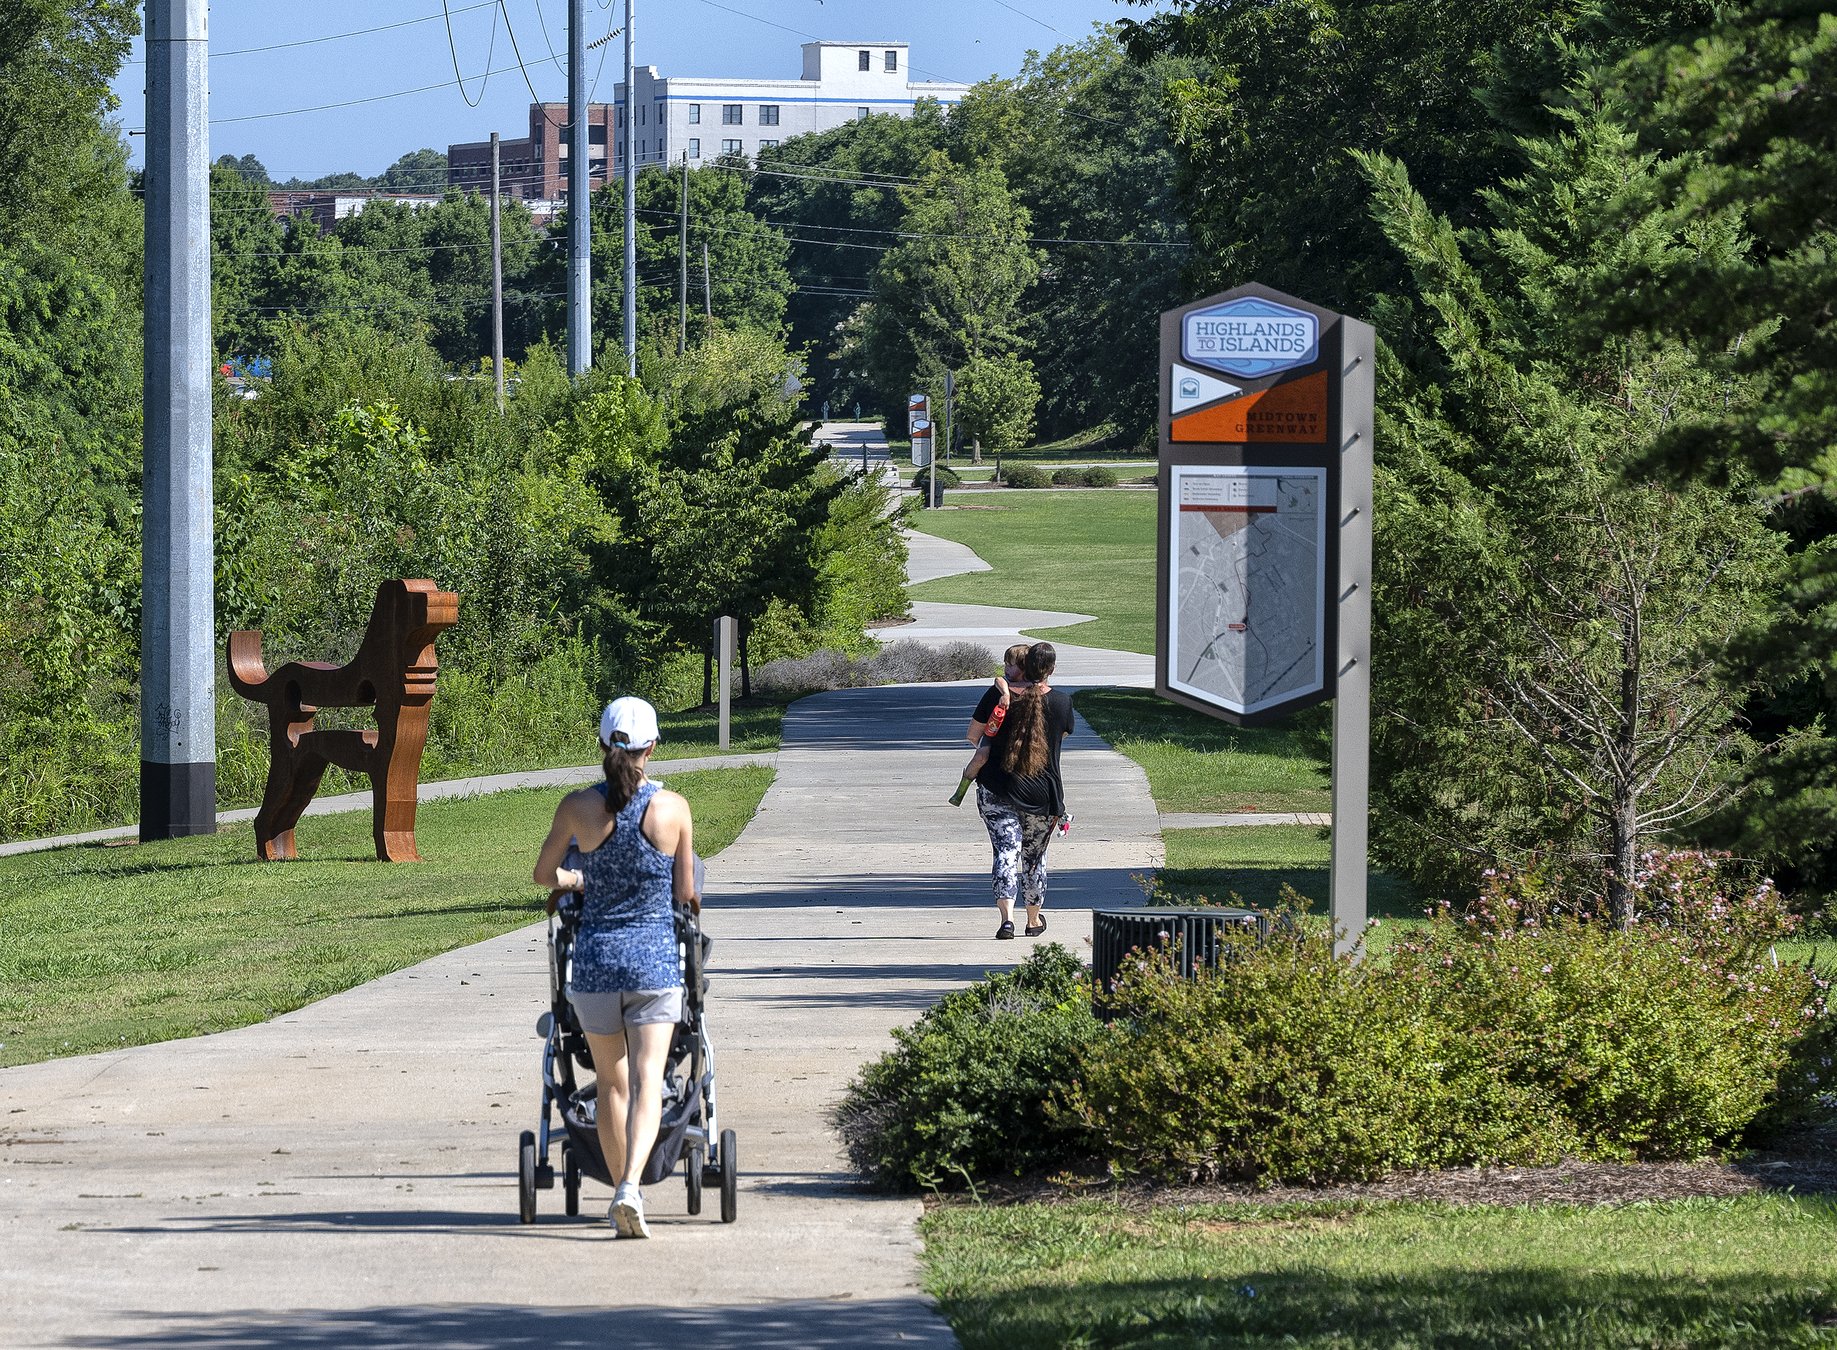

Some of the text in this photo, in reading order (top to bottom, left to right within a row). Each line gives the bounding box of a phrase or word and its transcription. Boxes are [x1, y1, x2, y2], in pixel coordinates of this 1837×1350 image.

[1196, 322, 1305, 336] HIGHLANDS
[1199, 337, 1305, 352] TO ISLANDS
[1247, 412, 1318, 422] MIDTOWN
[1235, 423, 1318, 434] GREENWAY
